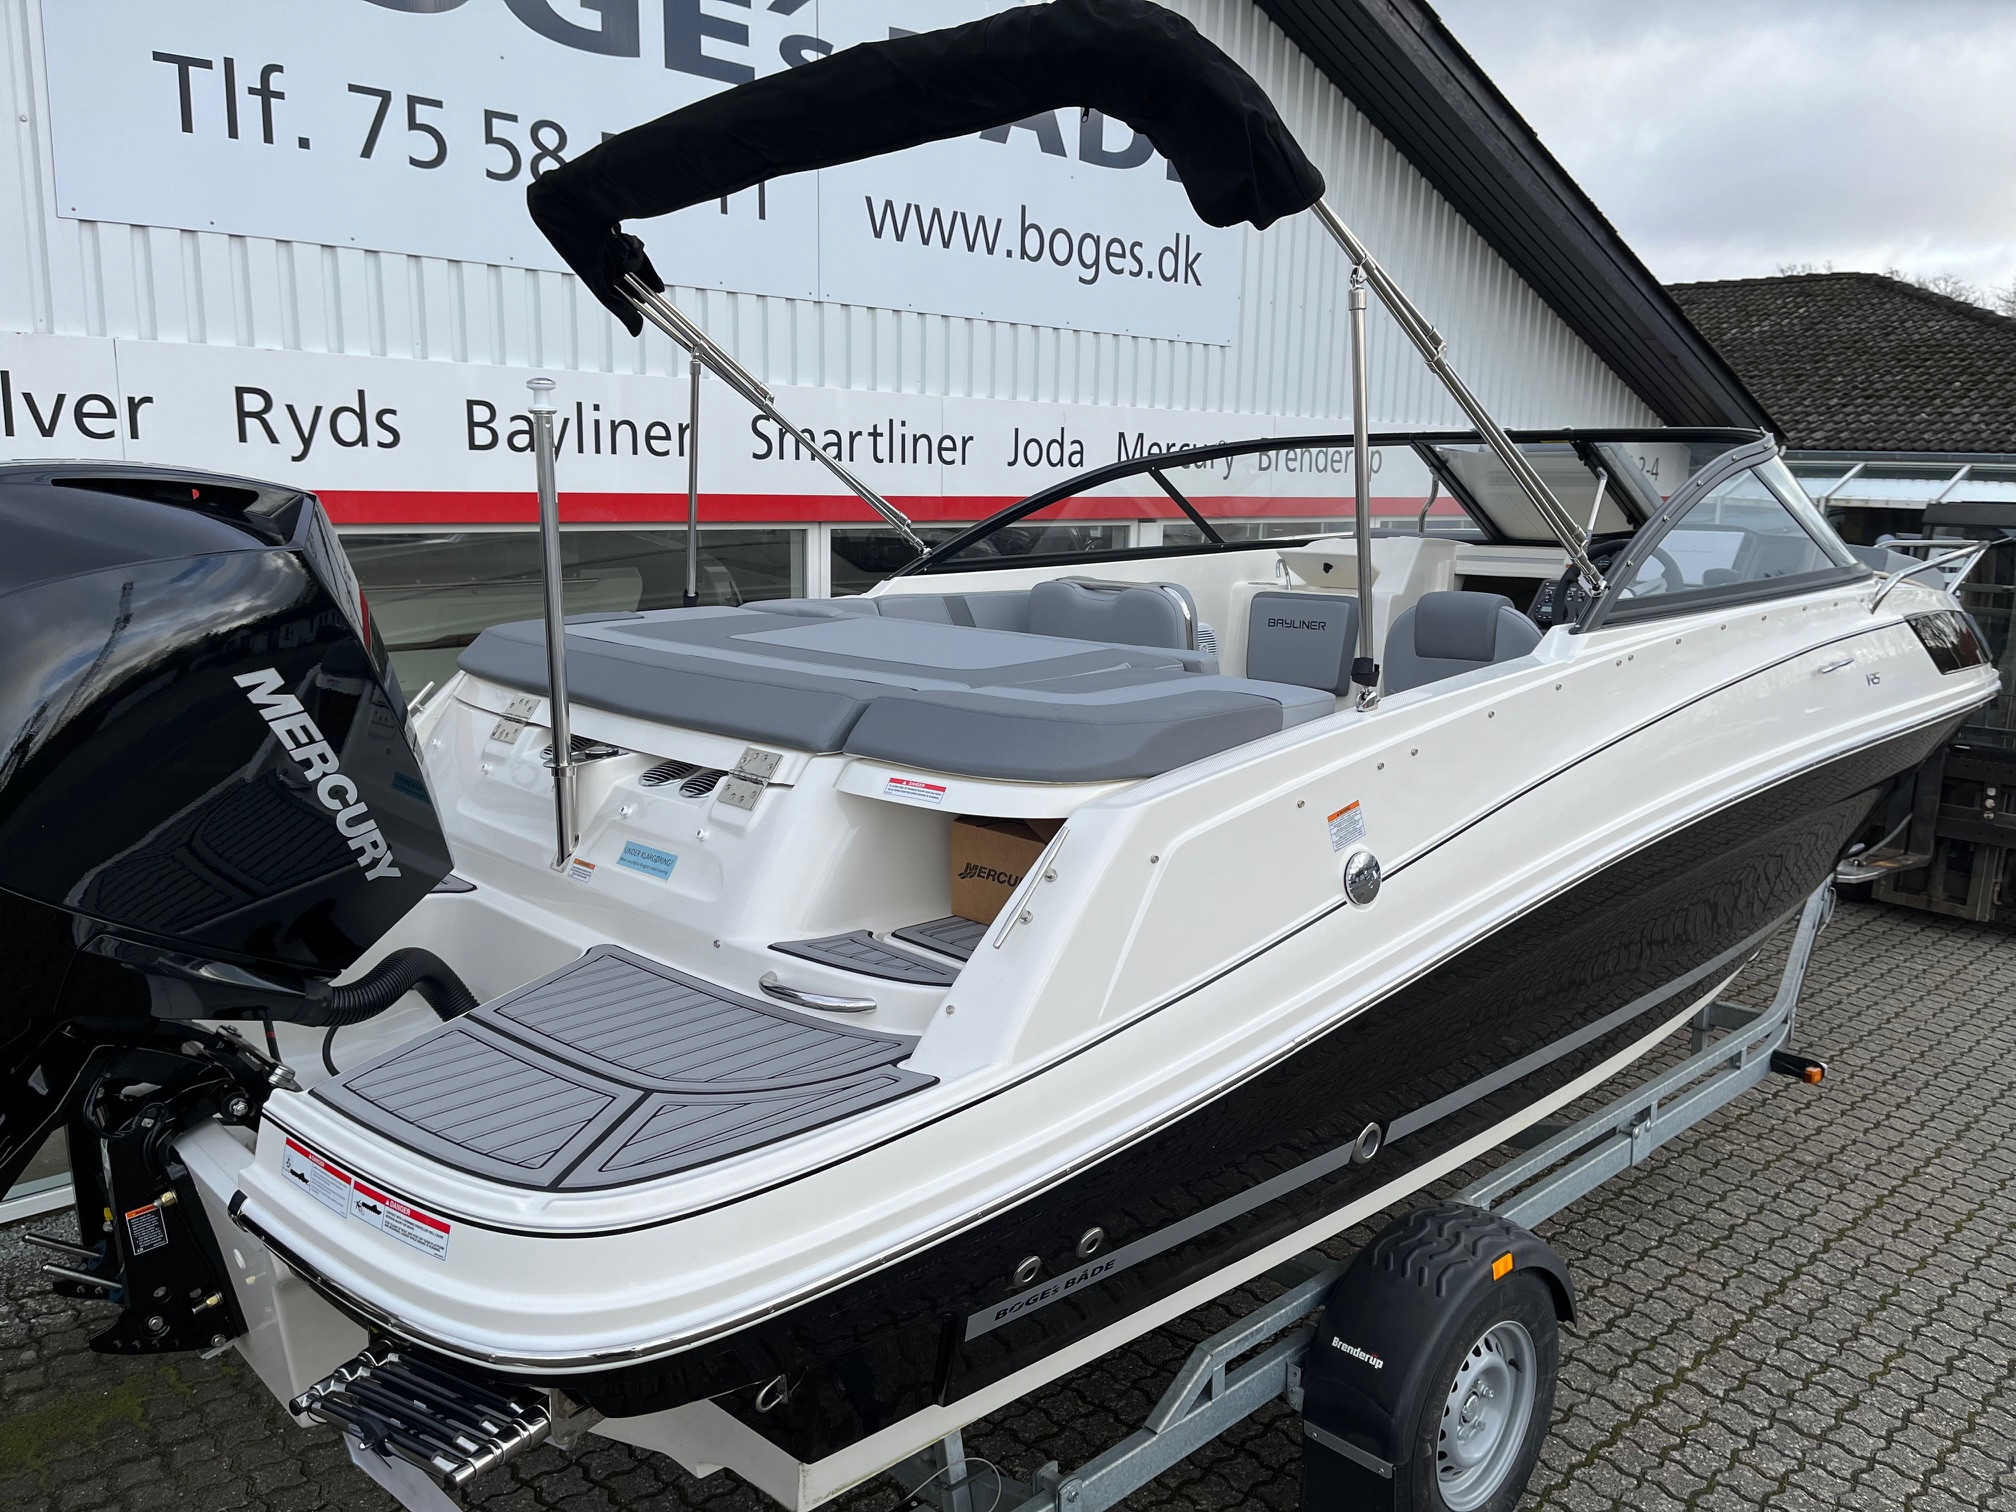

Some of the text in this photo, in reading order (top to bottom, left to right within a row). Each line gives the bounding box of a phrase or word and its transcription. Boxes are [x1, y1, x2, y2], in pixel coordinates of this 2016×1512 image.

[152, 51, 311, 149] Tlf.
[347, 83, 448, 170] 75
[484, 108, 568, 182] 58
[864, 195, 1203, 287] www.boges.dk
[234, 385, 402, 463] Ryds
[1007, 427, 1085, 468] Joda
[1257, 447, 1383, 482] Brenderp
[1267, 617, 1327, 631] BAYLINER
[232, 667, 402, 882] MERCURY
[958, 862, 1024, 888] MERCU
[389, 1200, 411, 1217] DANGER
[1063, 1259, 1116, 1291] BÅDE
[1331, 1336, 1384, 1369] Brenderup
